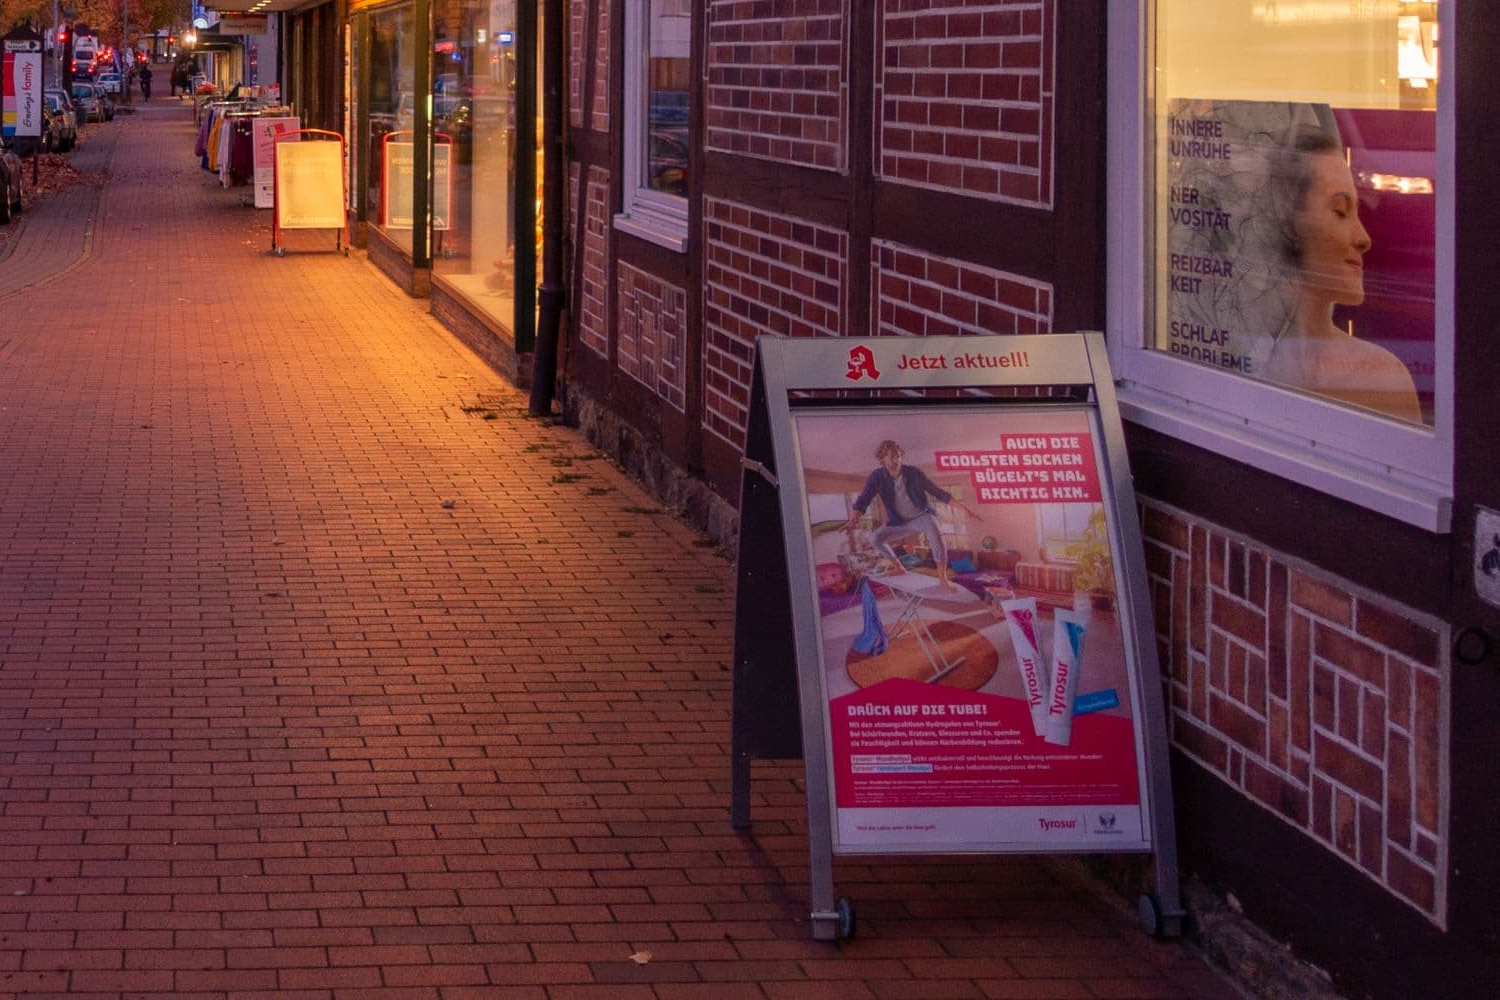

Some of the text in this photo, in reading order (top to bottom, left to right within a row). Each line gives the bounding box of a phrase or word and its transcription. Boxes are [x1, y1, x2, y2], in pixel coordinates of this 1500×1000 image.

[21, 61, 34, 93] family
[1170, 119, 1223, 139] INNERE
[1170, 140, 1231, 161] UNRUHE
[1170, 186, 1199, 205] NER
[1170, 205, 1232, 231] VOSITÄT
[1170, 254, 1233, 279] REIZBAR
[1170, 274, 1202, 295] KEIT
[1170, 321, 1230, 347] SCHLAF
[897, 351, 1030, 370] Jetzt aktuell!
[1006, 437, 1079, 450] AUCH DIE
[940, 454, 1083, 467] COOLSTEN SOCKEN
[975, 469, 1086, 483] BÜGELT'S MAL
[981, 487, 1089, 500] RICHTIG HIN.
[1022, 657, 1043, 709] Tyrosur
[1048, 660, 1069, 716] Tyrosur
[847, 702, 988, 716] DRÜCK AUF DIE TUBE!
